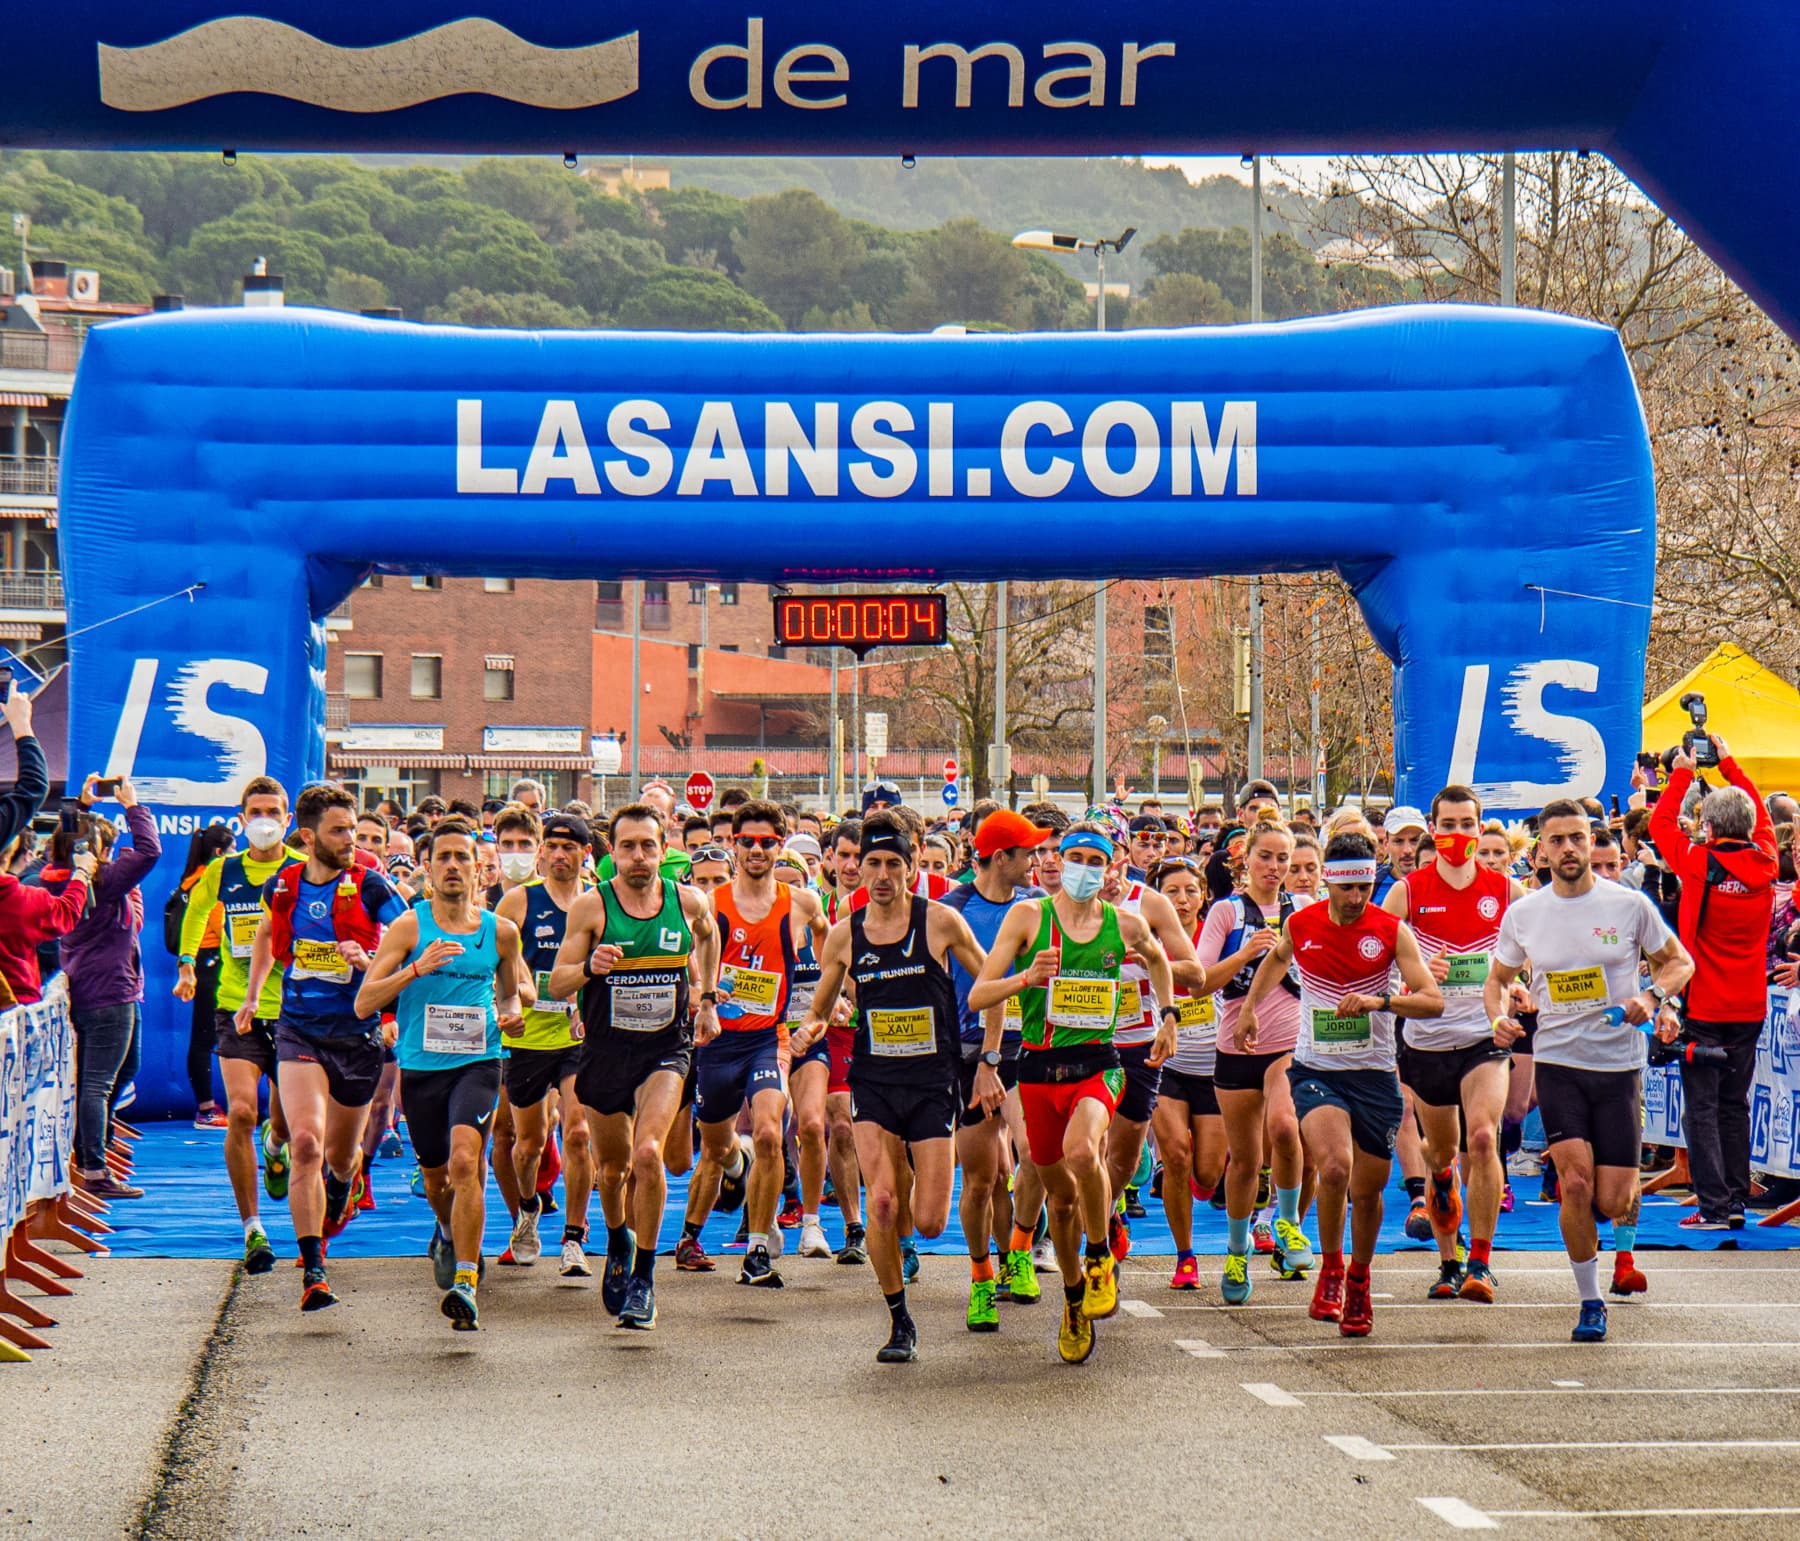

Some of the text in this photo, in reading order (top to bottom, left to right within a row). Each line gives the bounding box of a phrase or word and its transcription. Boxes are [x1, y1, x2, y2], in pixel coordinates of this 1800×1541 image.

[688, 16, 1176, 109] de mar
[455, 399, 1260, 497] LASANSI.COM
[783, 601, 937, 640] 00:00:04
[688, 786, 712, 796] STOP
[306, 953, 338, 963] MARC
[606, 973, 681, 985] CERDANYOLA
[1455, 970, 1470, 978] 692
[734, 981, 765, 993] MARC
[1557, 981, 1594, 993] KARIM
[1063, 994, 1103, 1005] MIQUEL
[636, 1003, 653, 1011] 953
[448, 1022, 465, 1032] 954
[888, 1023, 914, 1034] XAVI
[1324, 1021, 1357, 1032] JORDI
